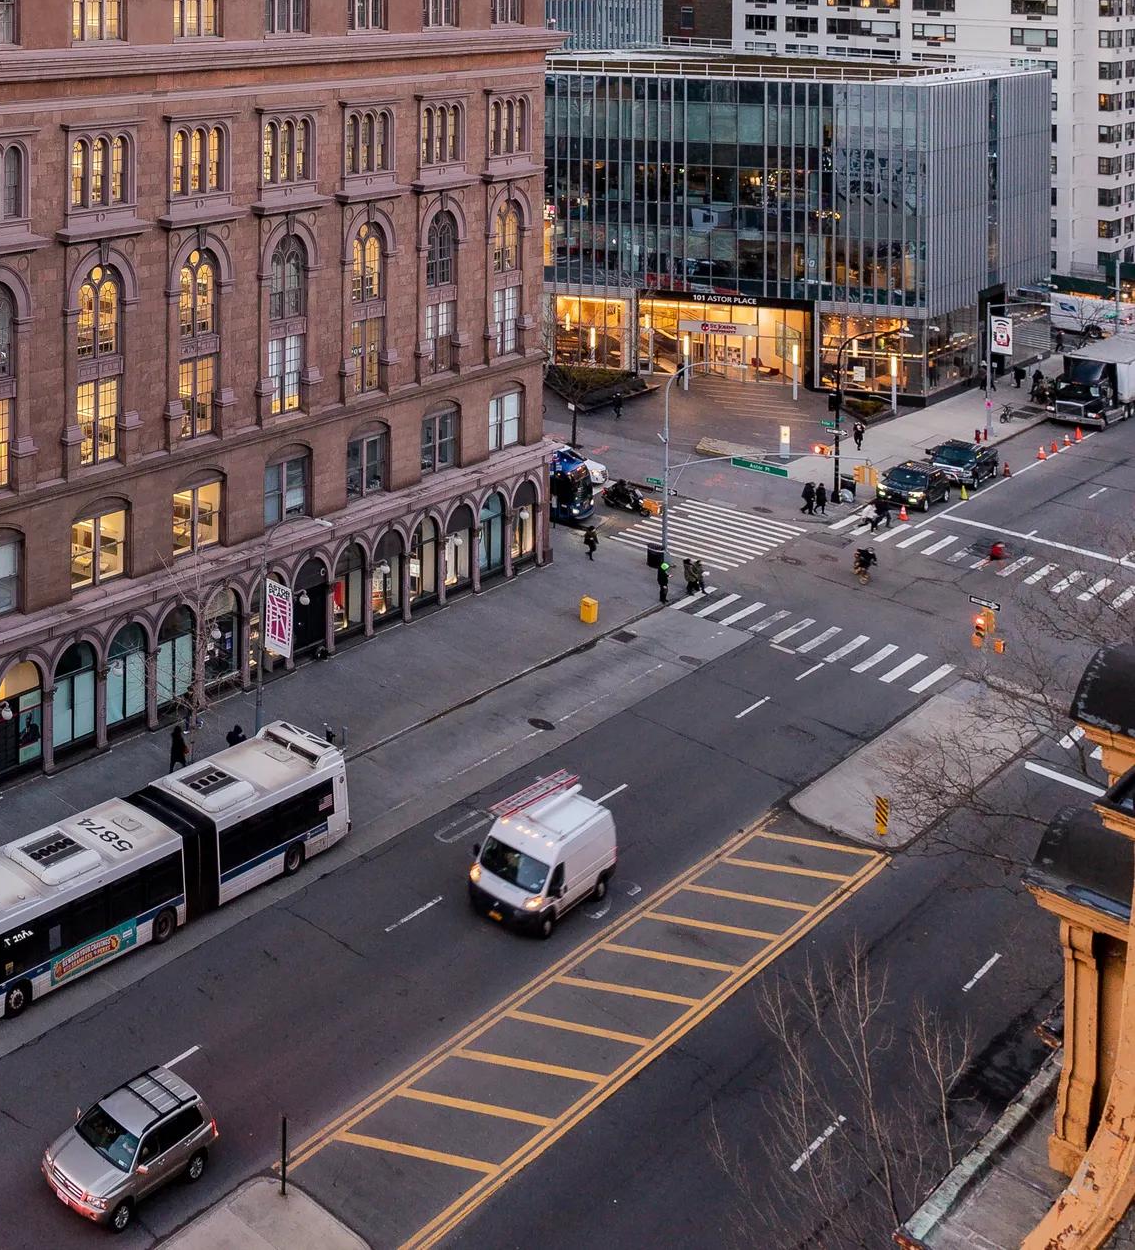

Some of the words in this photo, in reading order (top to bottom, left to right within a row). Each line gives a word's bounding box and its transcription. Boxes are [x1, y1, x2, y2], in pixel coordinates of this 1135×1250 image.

[707, 295, 732, 303] ASTOR
[733, 297, 757, 305] PLACE
[269, 583, 290, 596] ASTOR
[269, 588, 290, 601] PLACE
[76, 818, 134, 852] 5874
